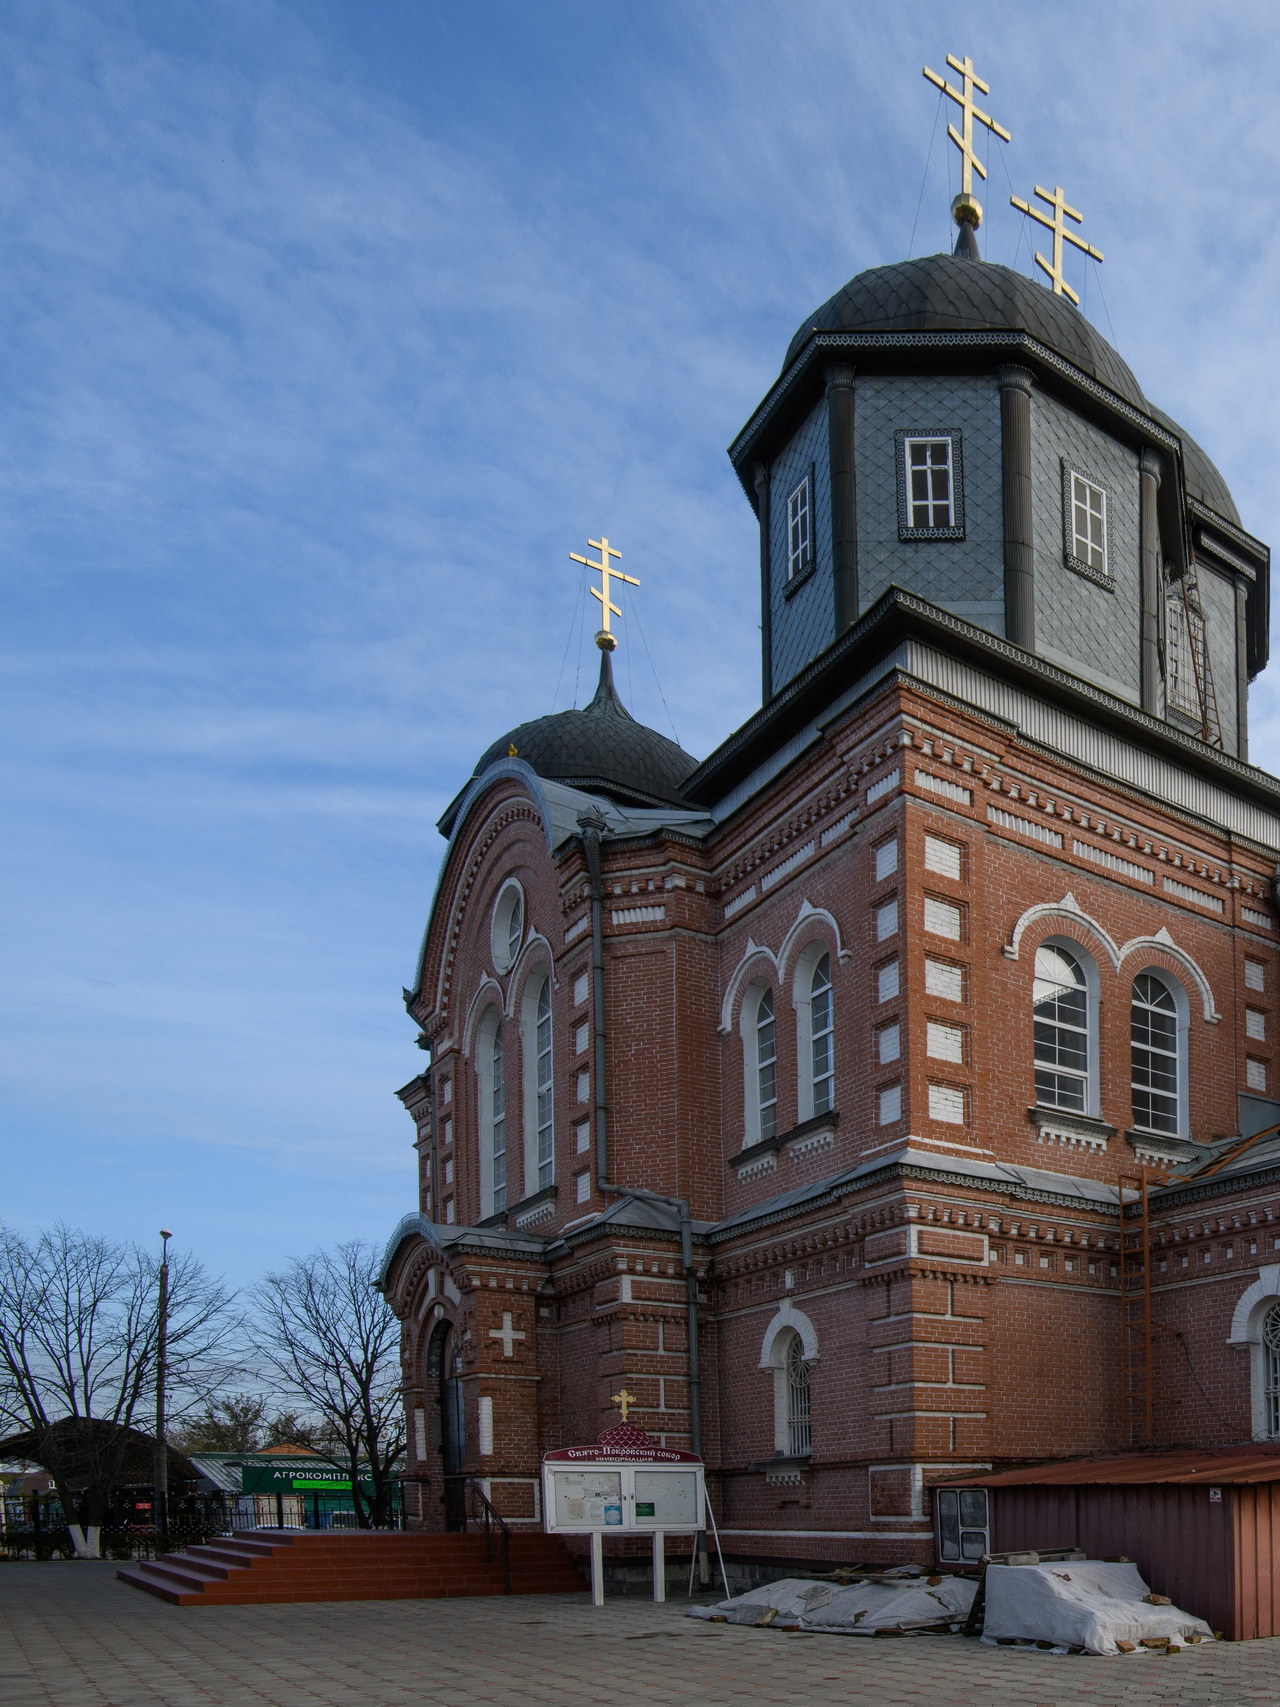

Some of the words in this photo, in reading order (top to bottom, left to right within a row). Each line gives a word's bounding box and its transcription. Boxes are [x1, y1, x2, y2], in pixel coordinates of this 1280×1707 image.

[568, 1447, 655, 1458] Свято-Покровский
[657, 1450, 681, 1462] собор
[273, 1471, 372, 1481] АГРОКОМПЛКС
